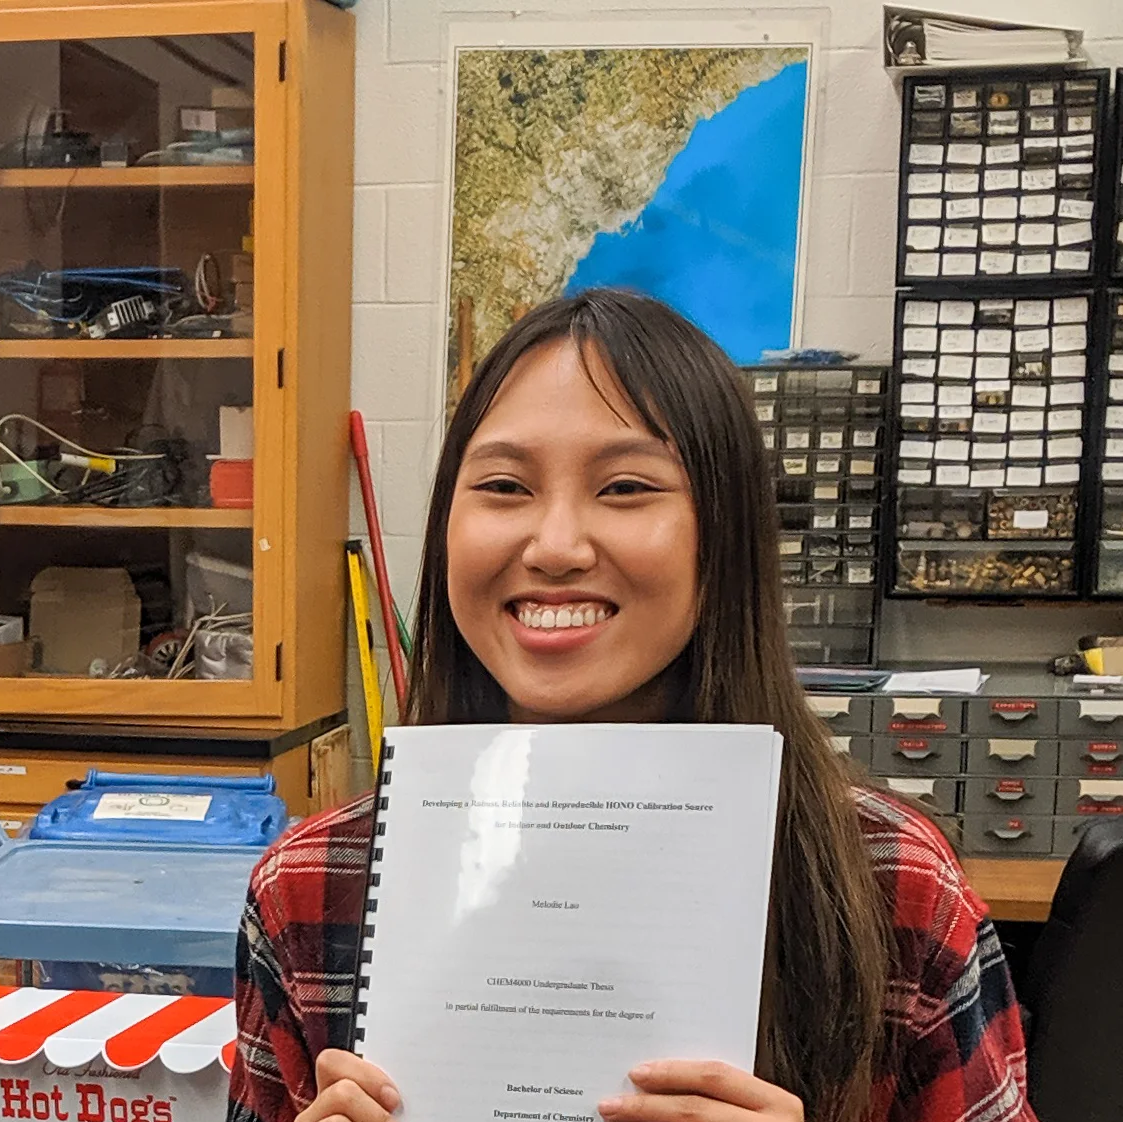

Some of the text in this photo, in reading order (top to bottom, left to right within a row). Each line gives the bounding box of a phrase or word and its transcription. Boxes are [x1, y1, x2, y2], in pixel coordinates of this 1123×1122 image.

[422, 800, 463, 808] Developing
[552, 801, 604, 810] Reproducible
[606, 802, 634, 810] HONO
[637, 802, 682, 811] Calibration
[684, 803, 714, 811] Source
[537, 821, 551, 829] and
[553, 822, 585, 830] Outdoor
[588, 822, 630, 832] Chemistry
[532, 900, 562, 909] Melodie
[487, 978, 614, 991] CHEM4000 Undergraduate Thesis
[455, 1003, 478, 1013] partial
[519, 1005, 527, 1013] of
[528, 1006, 540, 1014] the
[542, 1006, 590, 1017] requirements
[593, 1008, 604, 1016] for
[606, 1009, 618, 1018] the
[619, 1010, 645, 1020] degree
[646, 1011, 656, 1020] of
[507, 1084, 584, 1096] Bachelor of Science
[0, 1078, 68, 1121] Hot
[493, 1109, 541, 1120] Department
[543, 1112, 551, 1120] of
